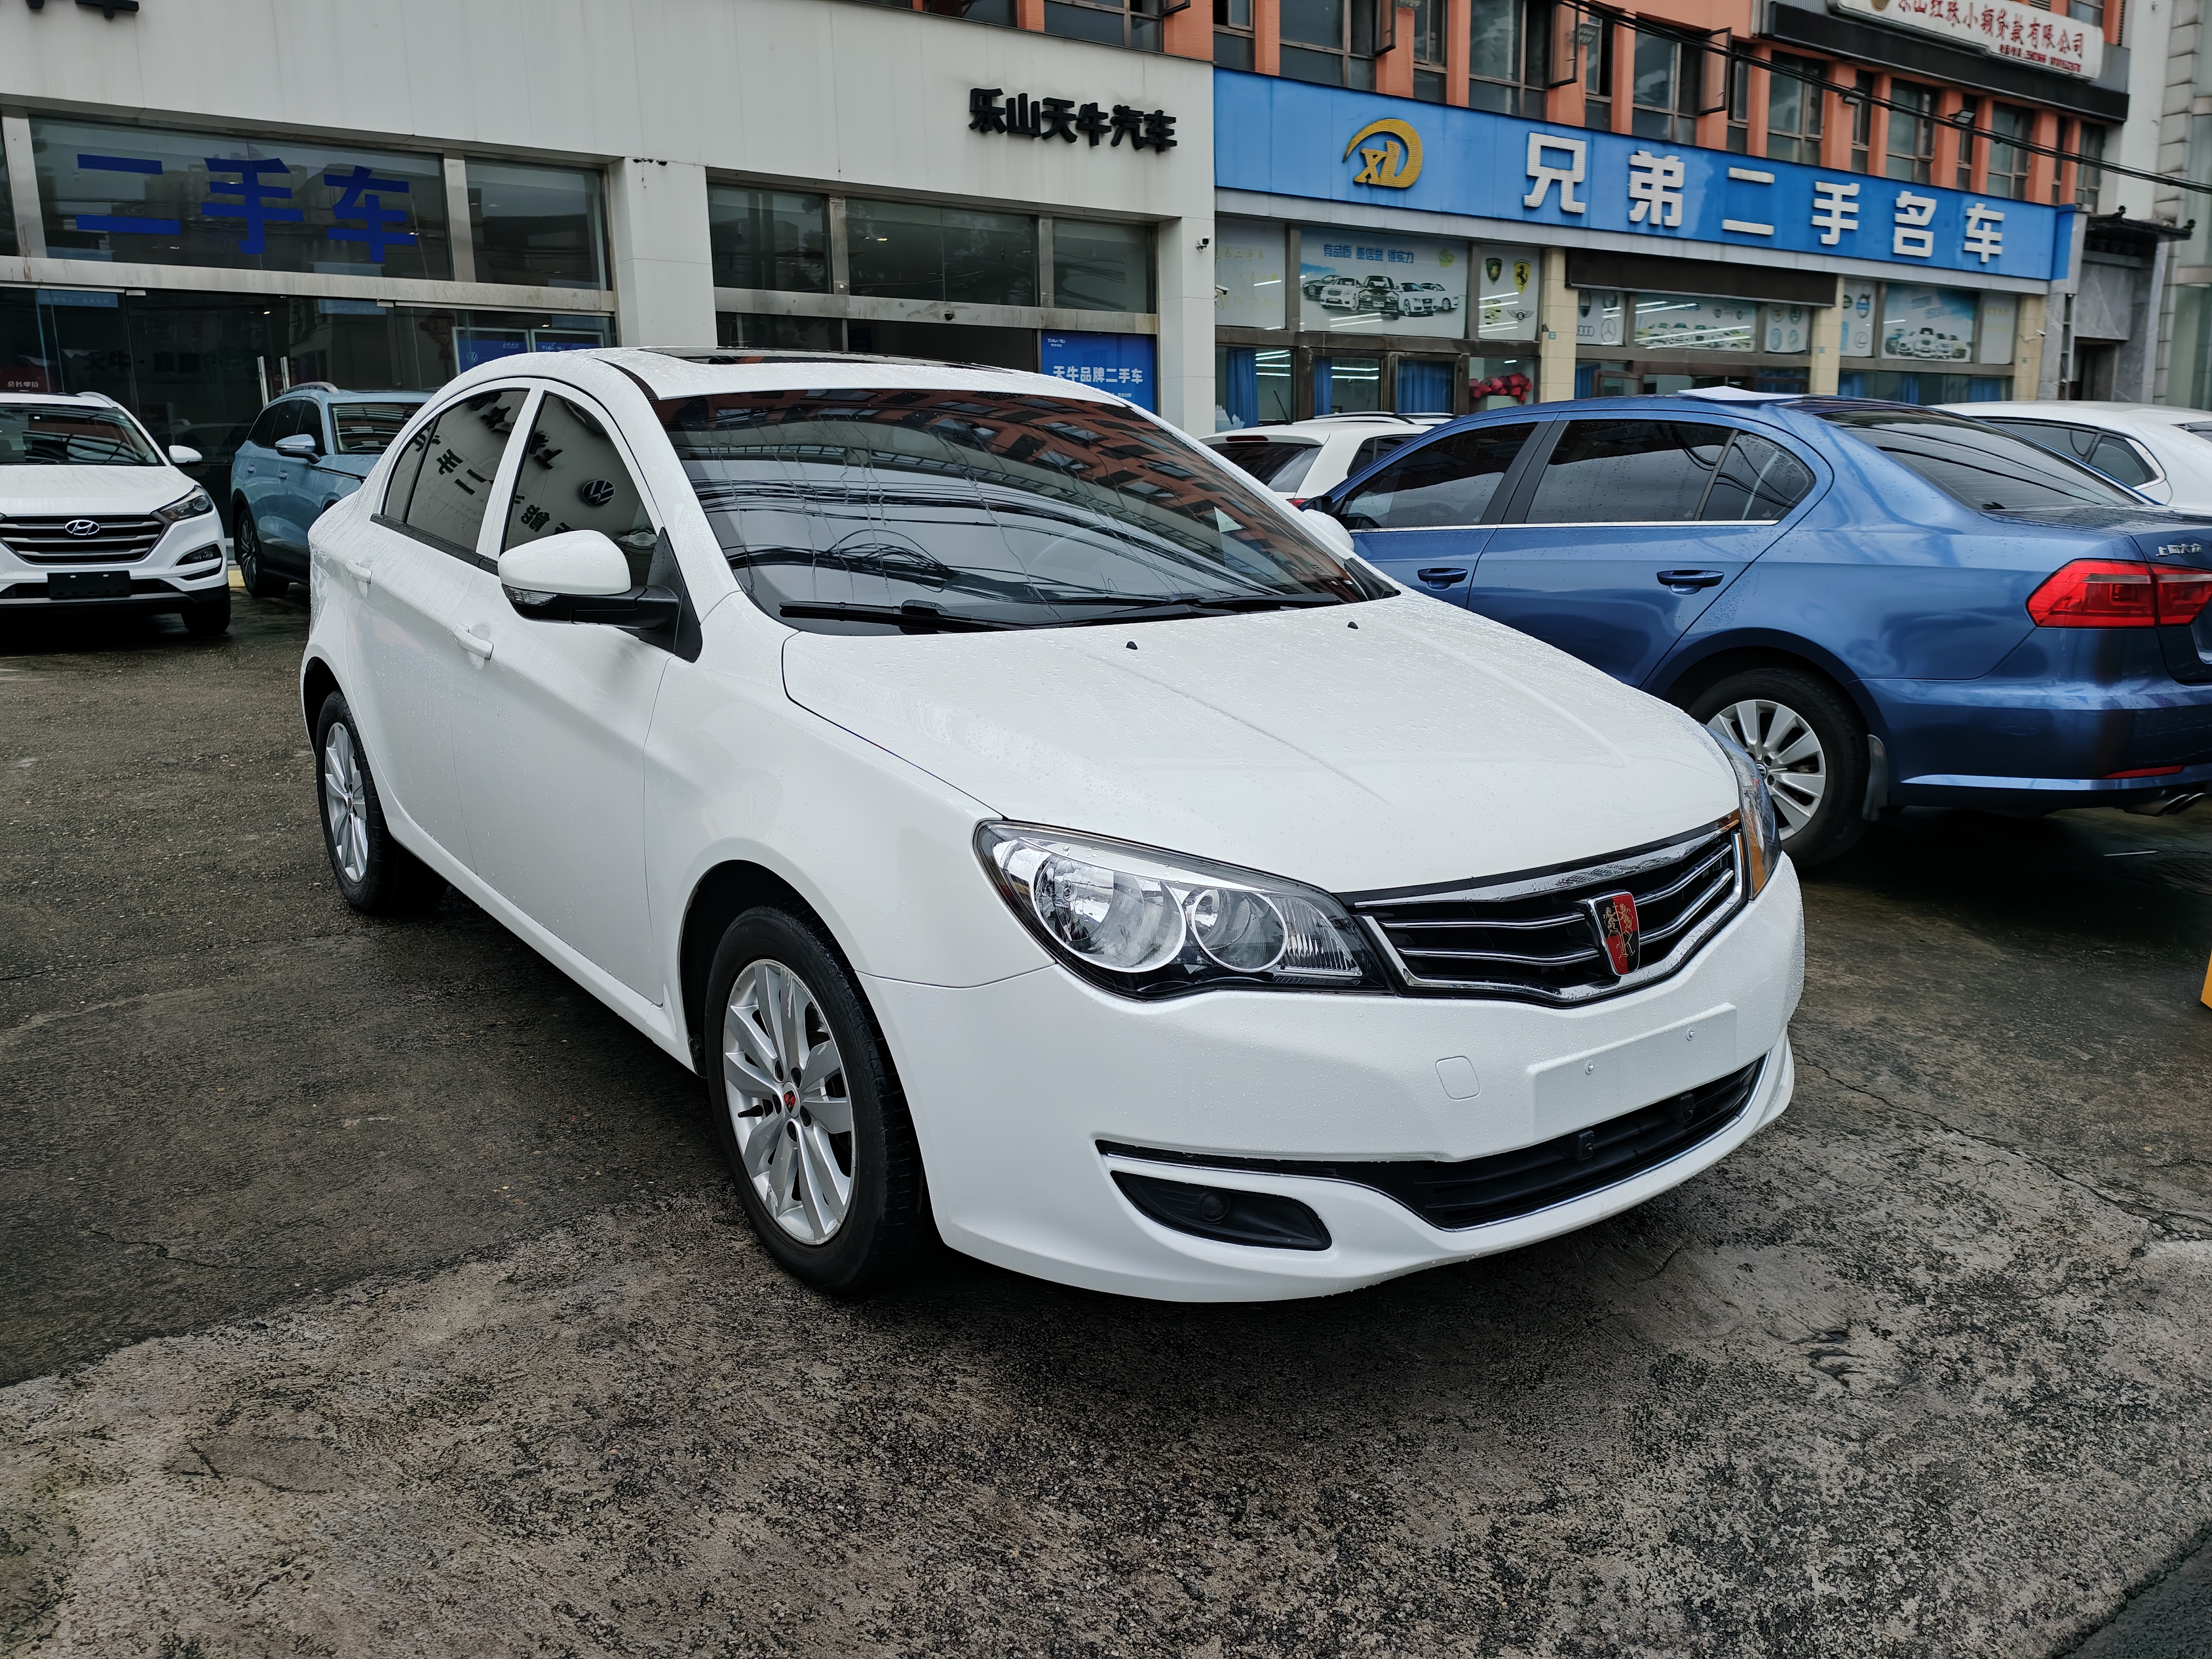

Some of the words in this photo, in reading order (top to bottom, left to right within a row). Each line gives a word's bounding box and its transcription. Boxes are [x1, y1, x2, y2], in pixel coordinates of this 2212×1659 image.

[969, 87, 1178, 153] 乐山天牛汽车
[76, 154, 416, 263] 二手车
[1524, 132, 2005, 263] 兄弟二手名车
[1053, 366, 1143, 384] 天牛品牌二手车
